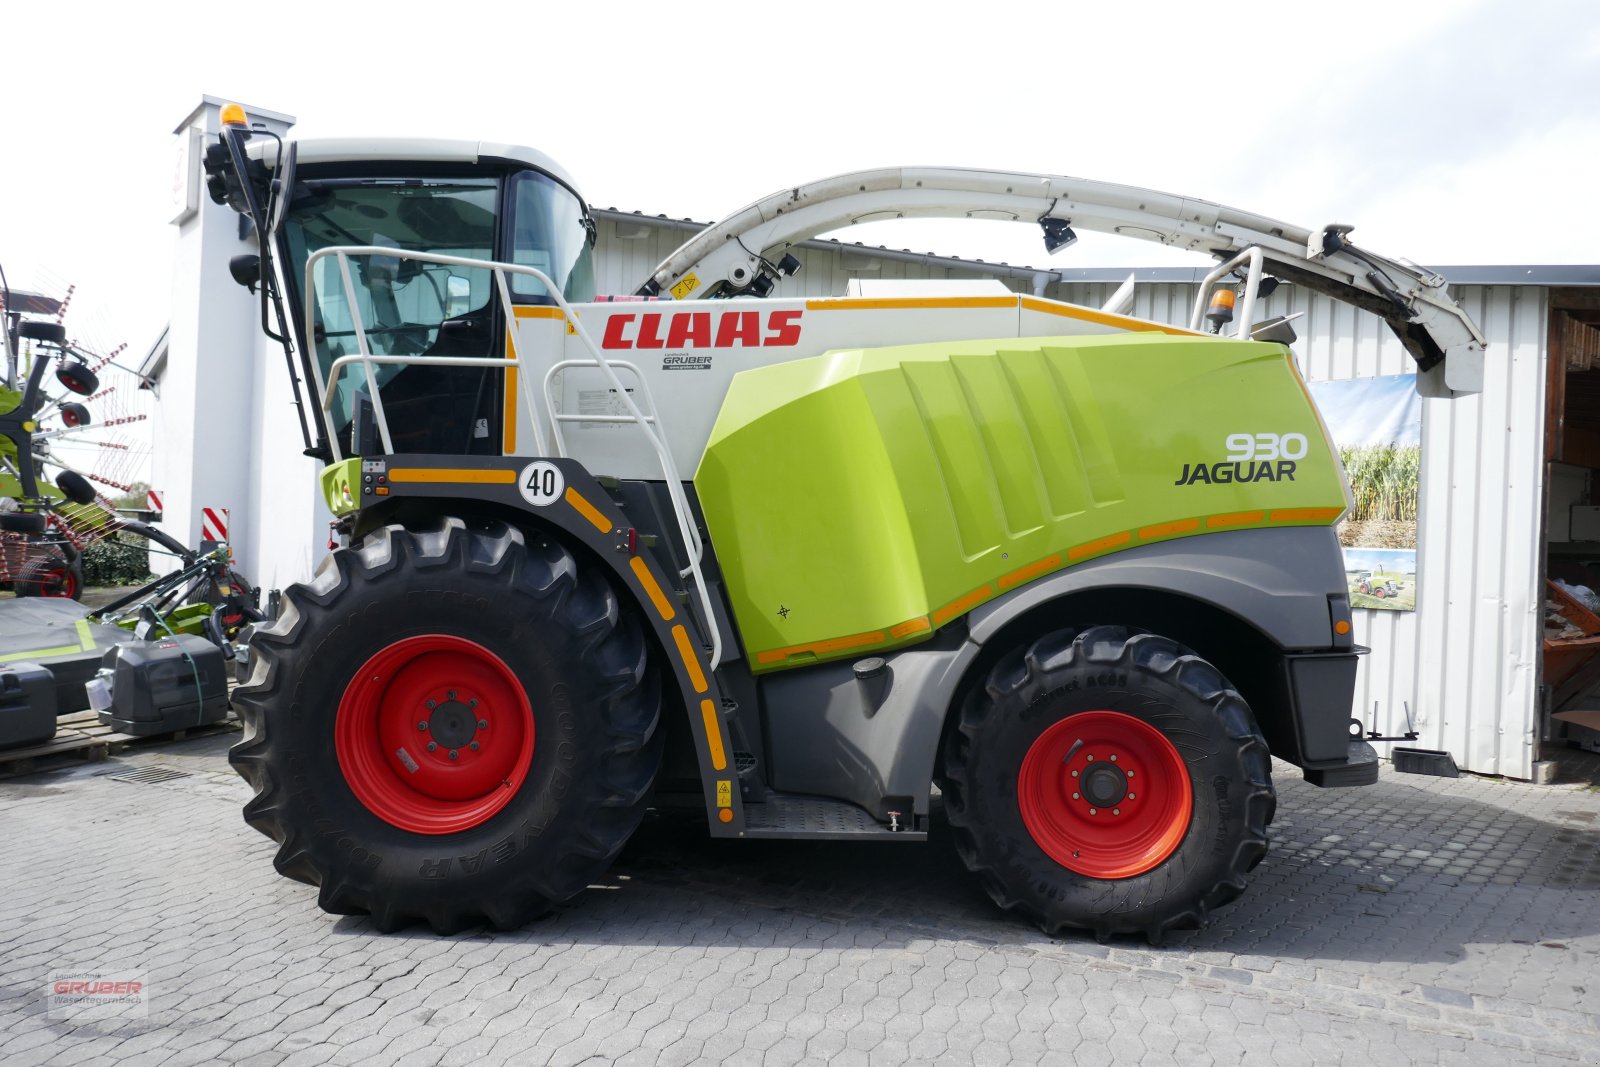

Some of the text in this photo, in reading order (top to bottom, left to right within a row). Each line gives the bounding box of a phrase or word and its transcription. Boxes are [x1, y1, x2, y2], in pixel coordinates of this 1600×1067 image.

[602, 311, 803, 349] CLAAS
[1226, 432, 1308, 461] 930
[527, 469, 555, 497] 40
[1175, 461, 1297, 486] JAGUAR
[418, 682, 577, 880] GOODYEAR
